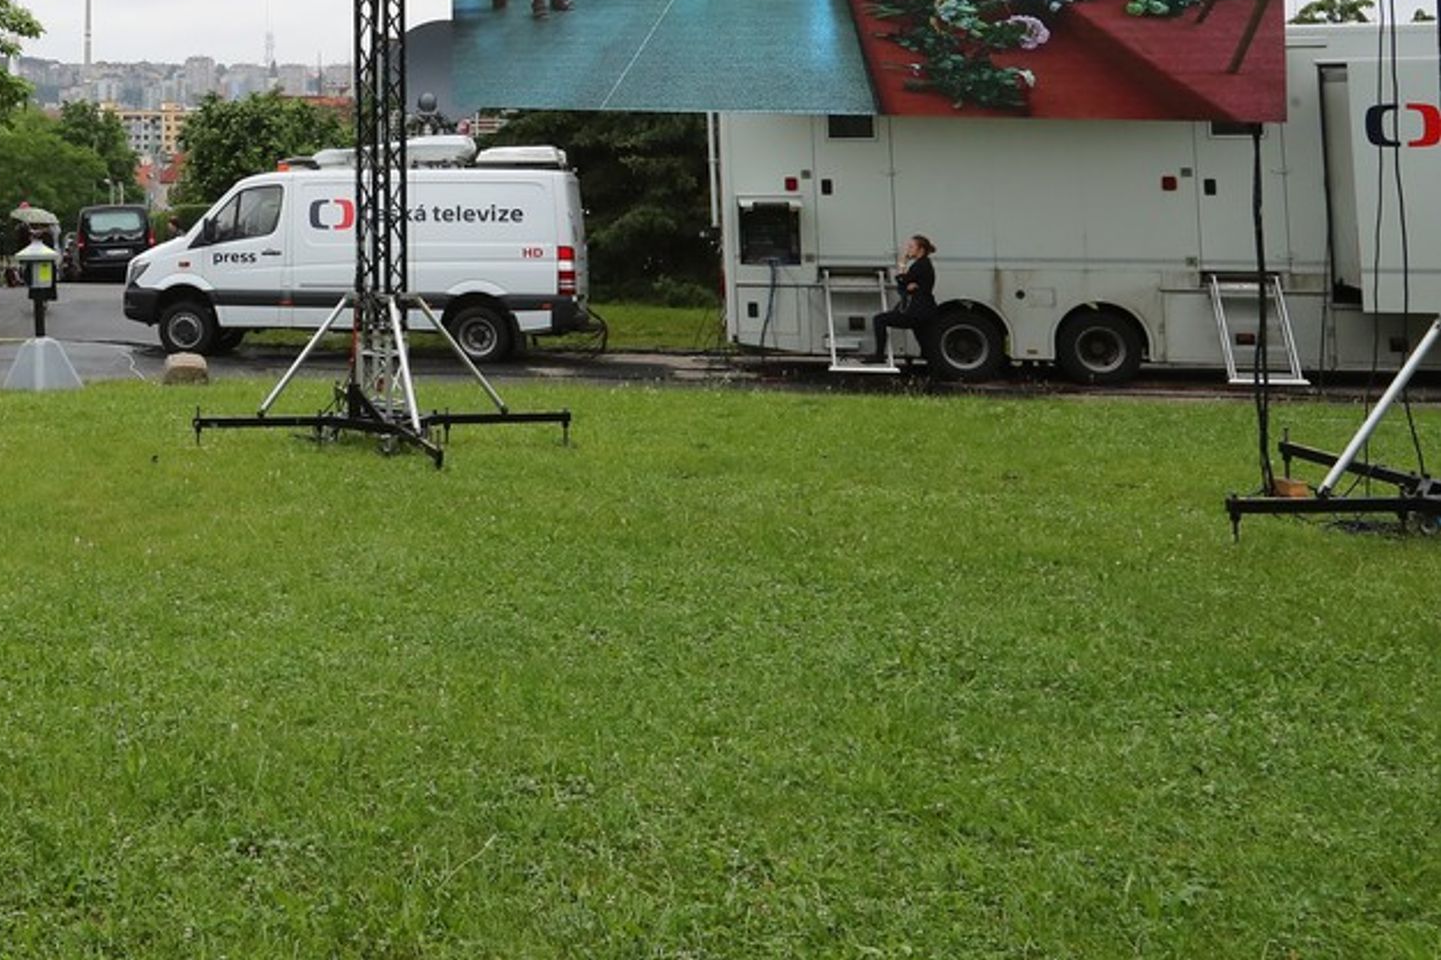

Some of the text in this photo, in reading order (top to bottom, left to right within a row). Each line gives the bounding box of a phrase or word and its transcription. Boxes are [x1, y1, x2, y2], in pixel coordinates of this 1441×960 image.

[432, 204, 524, 223] televize
[213, 252, 257, 265] press
[522, 247, 544, 258] HD
